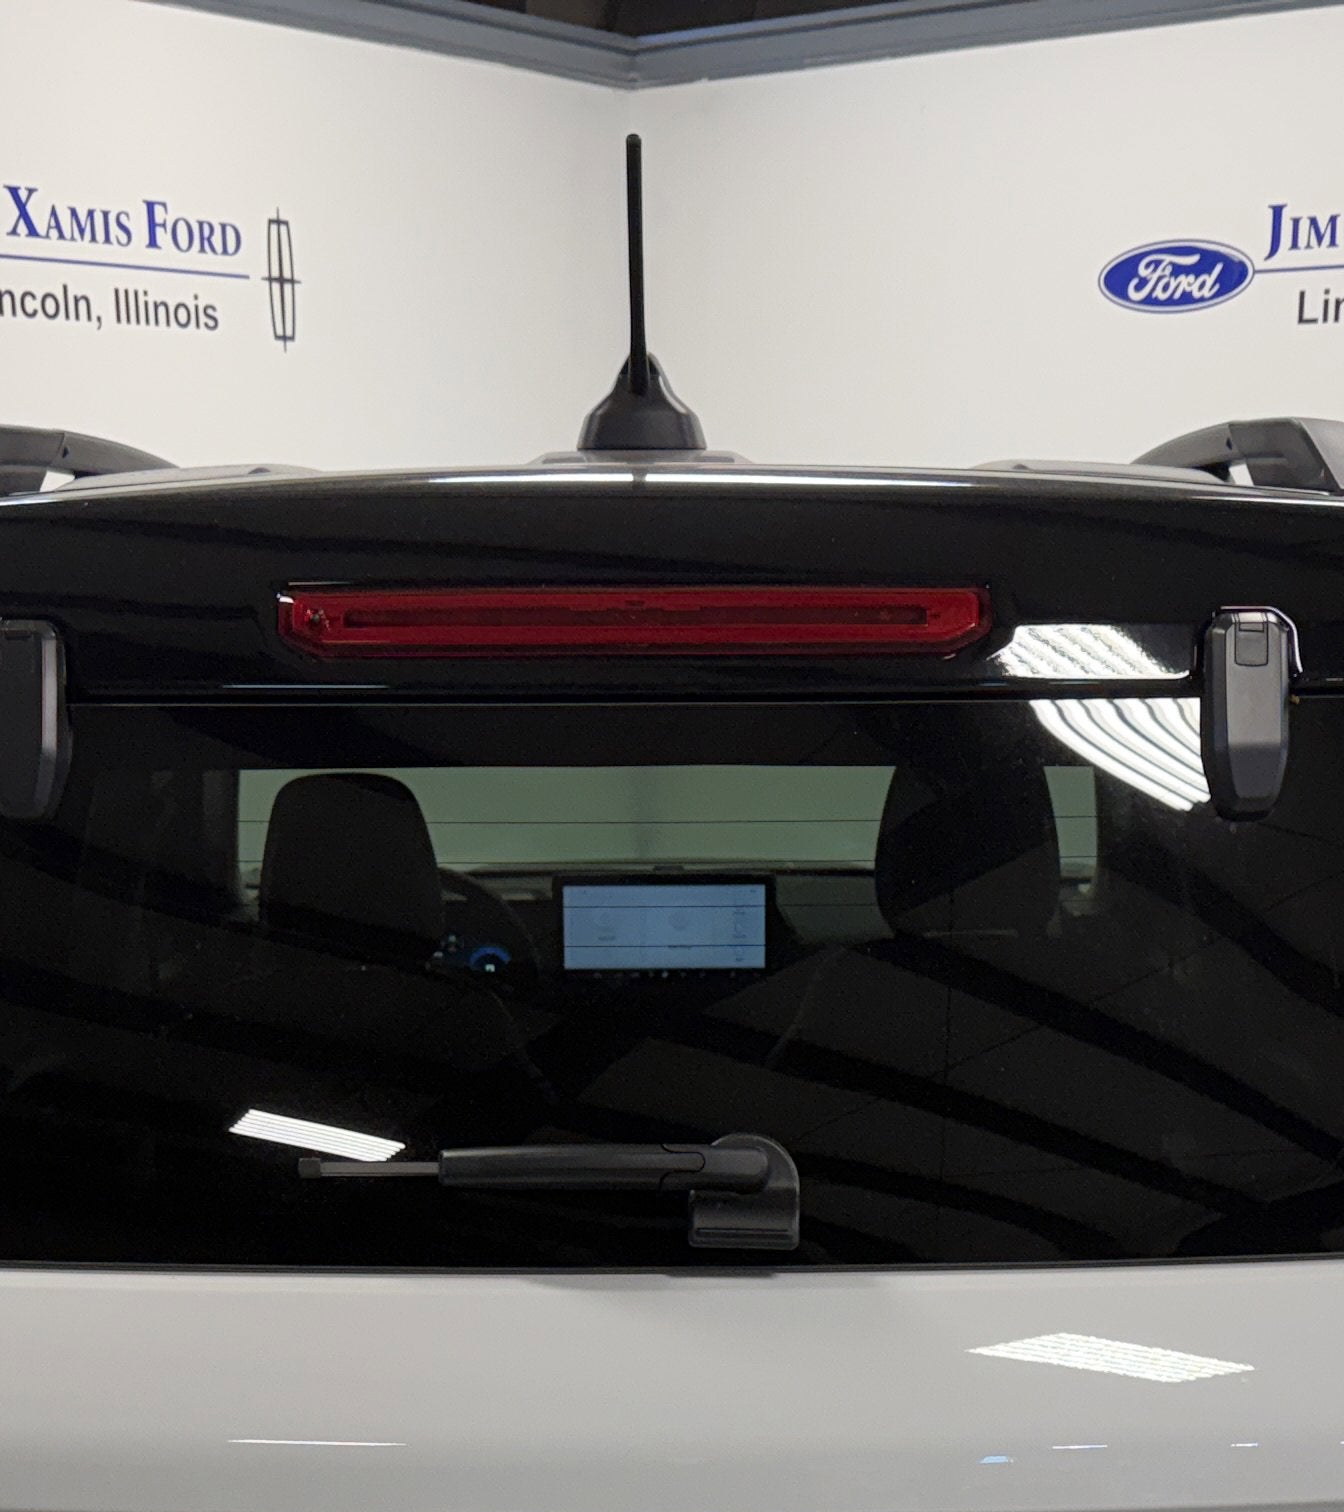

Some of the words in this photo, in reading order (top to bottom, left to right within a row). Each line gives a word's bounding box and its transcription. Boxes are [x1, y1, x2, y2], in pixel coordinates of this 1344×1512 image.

[3, 185, 133, 247] XAMIS
[142, 200, 242, 258] FORD
[1263, 203, 1341, 262] JIM
[1127, 252, 1222, 303] Ford
[113, 288, 219, 332] Illinois
